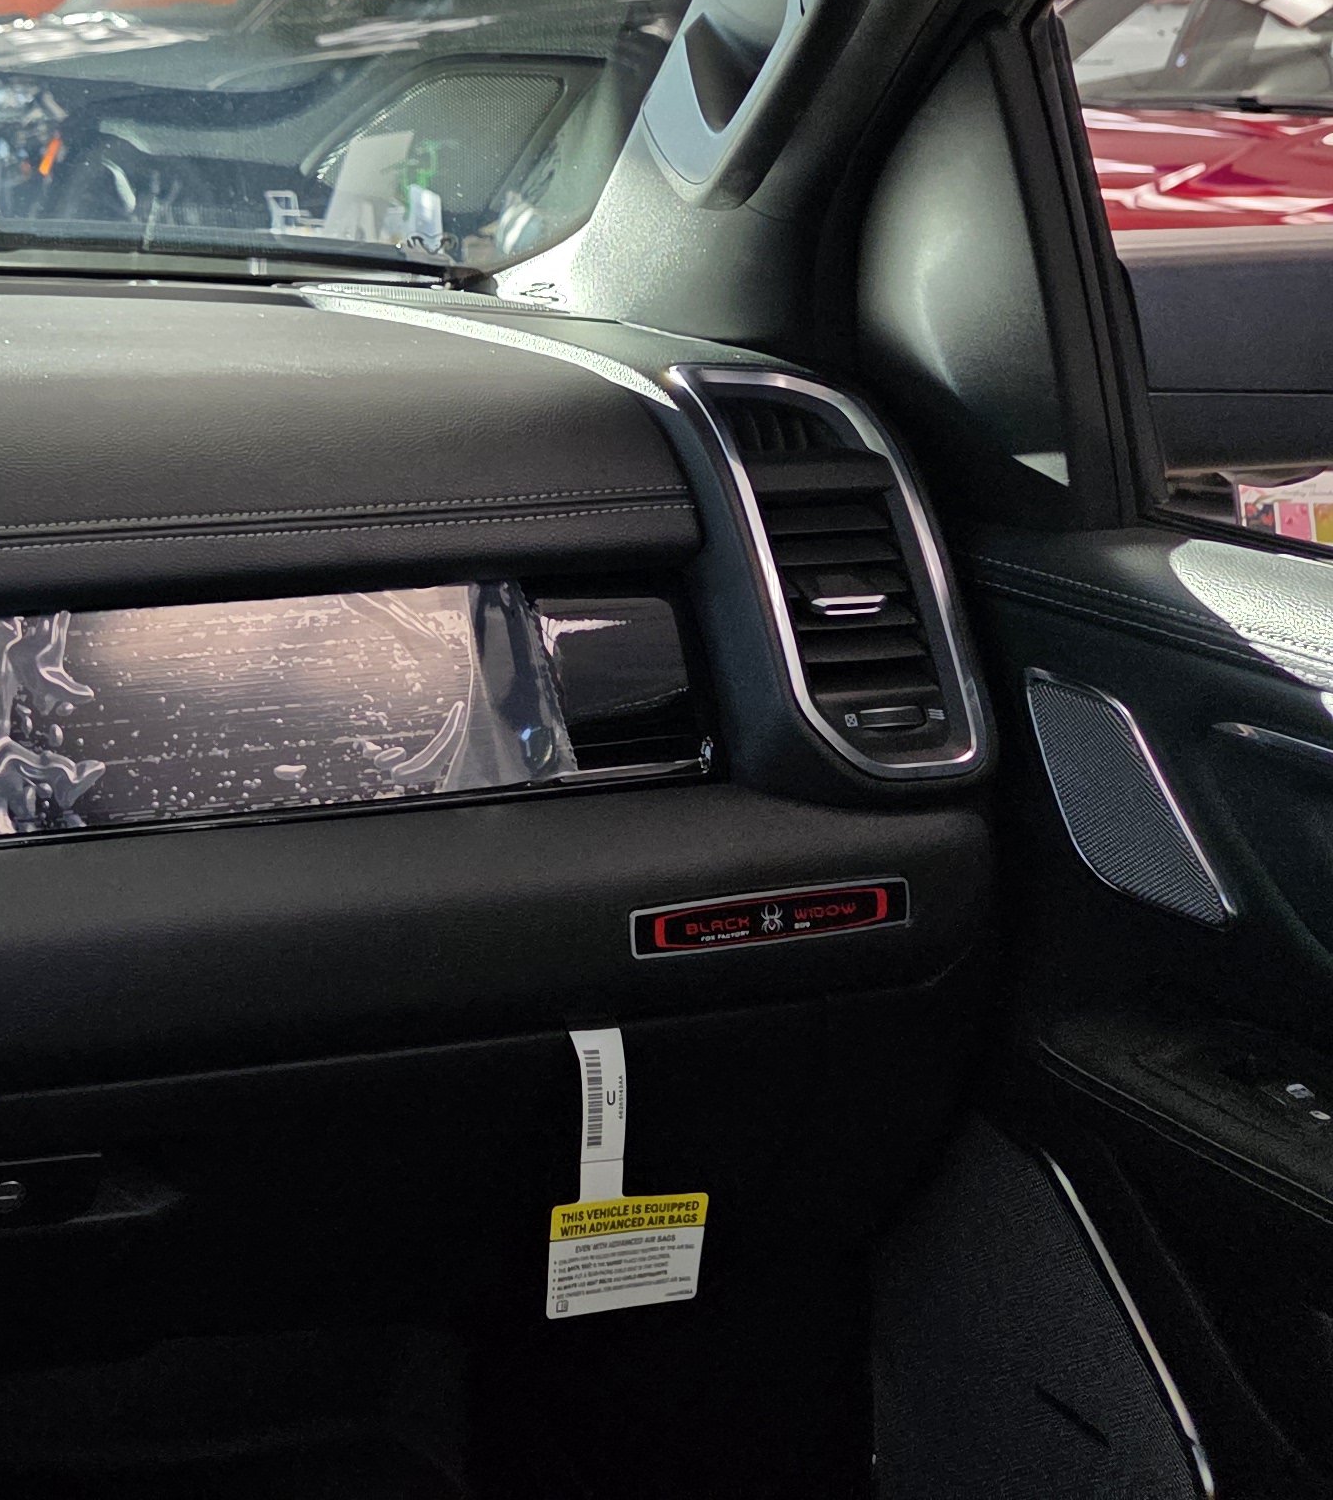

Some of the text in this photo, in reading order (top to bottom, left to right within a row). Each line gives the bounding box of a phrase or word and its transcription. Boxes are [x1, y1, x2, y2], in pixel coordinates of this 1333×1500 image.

[685, 901, 857, 935] BLACK WIDOW
[717, 930, 750, 940] FACTORY
[561, 1200, 700, 1224] THIS VEHICLE IS EQUIPPED
[560, 1213, 698, 1237] WITH ADVANCED AIR BAGS
[645, 1236, 657, 1244] AIR
[657, 1234, 676, 1243] BAGS
